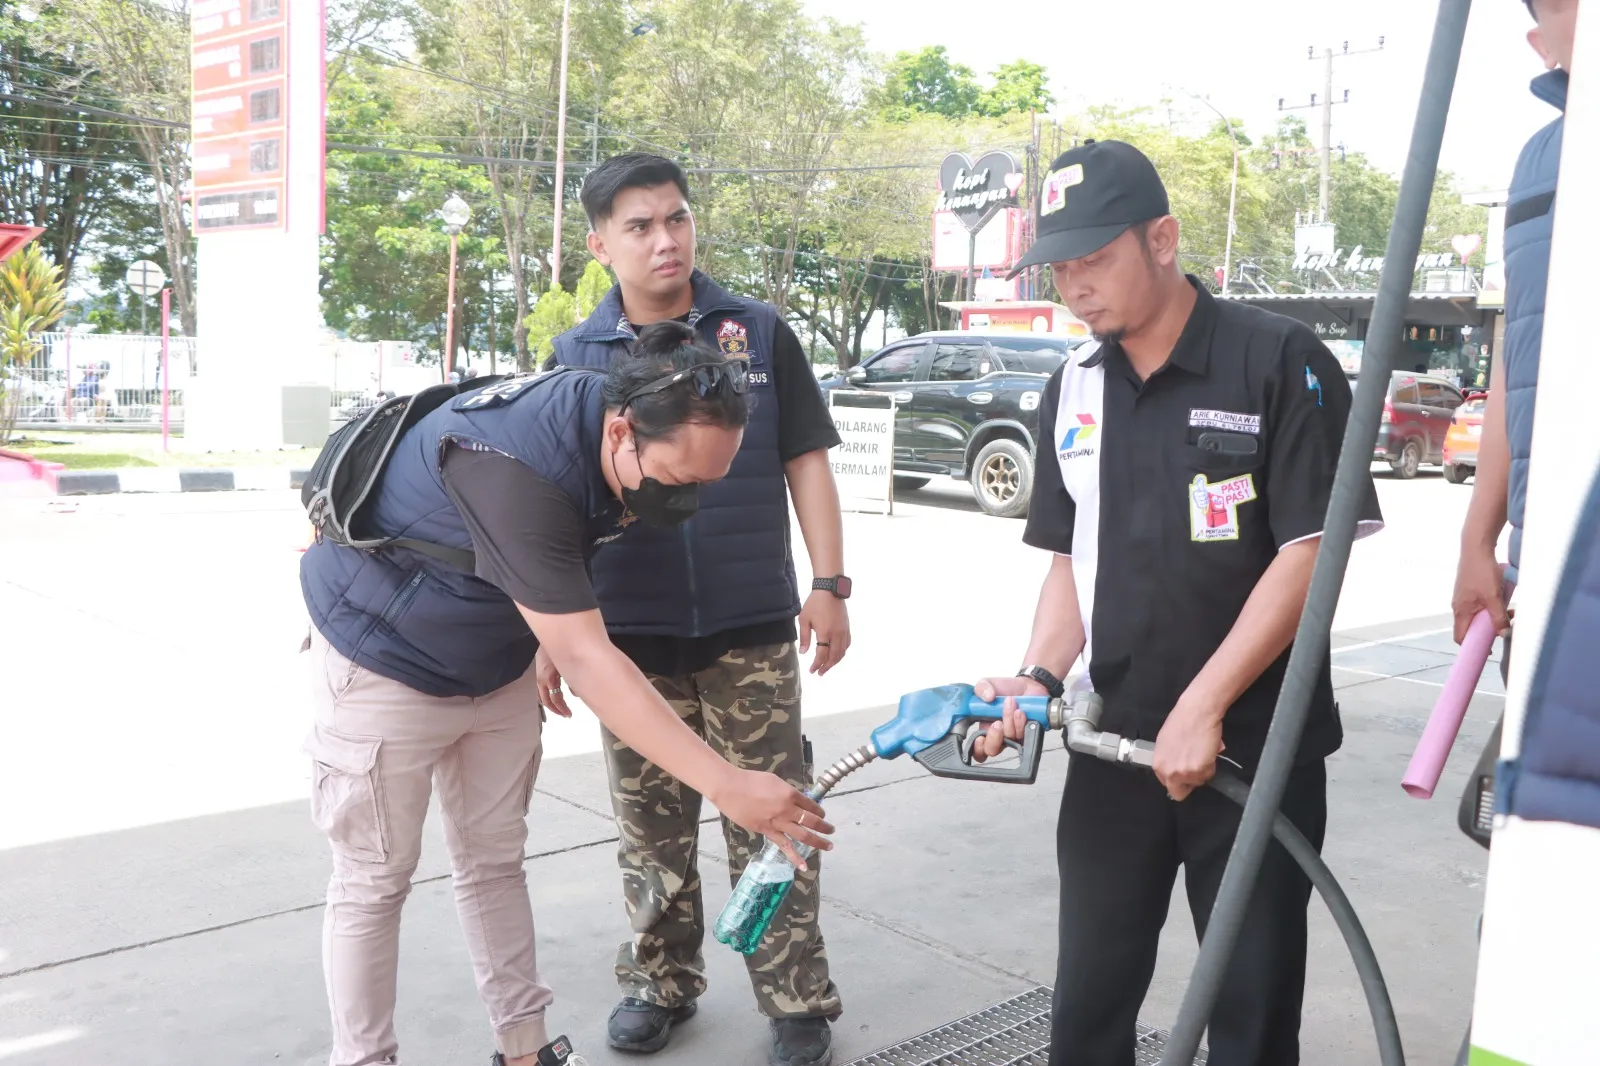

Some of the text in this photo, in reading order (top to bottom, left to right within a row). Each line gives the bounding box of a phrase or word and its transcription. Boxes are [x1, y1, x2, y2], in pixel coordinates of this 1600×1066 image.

[953, 168, 989, 190] kopi
[1292, 244, 1454, 272] kopi kengan
[1315, 322, 1326, 334] No
[749, 372, 768, 384] SUS
[1193, 411, 1211, 419] ARIE
[834, 420, 887, 434] DILARANG
[839, 442, 879, 454] PARKIR
[1059, 448, 1095, 461] PERTAMINA
[1221, 477, 1249, 494] PASTI
